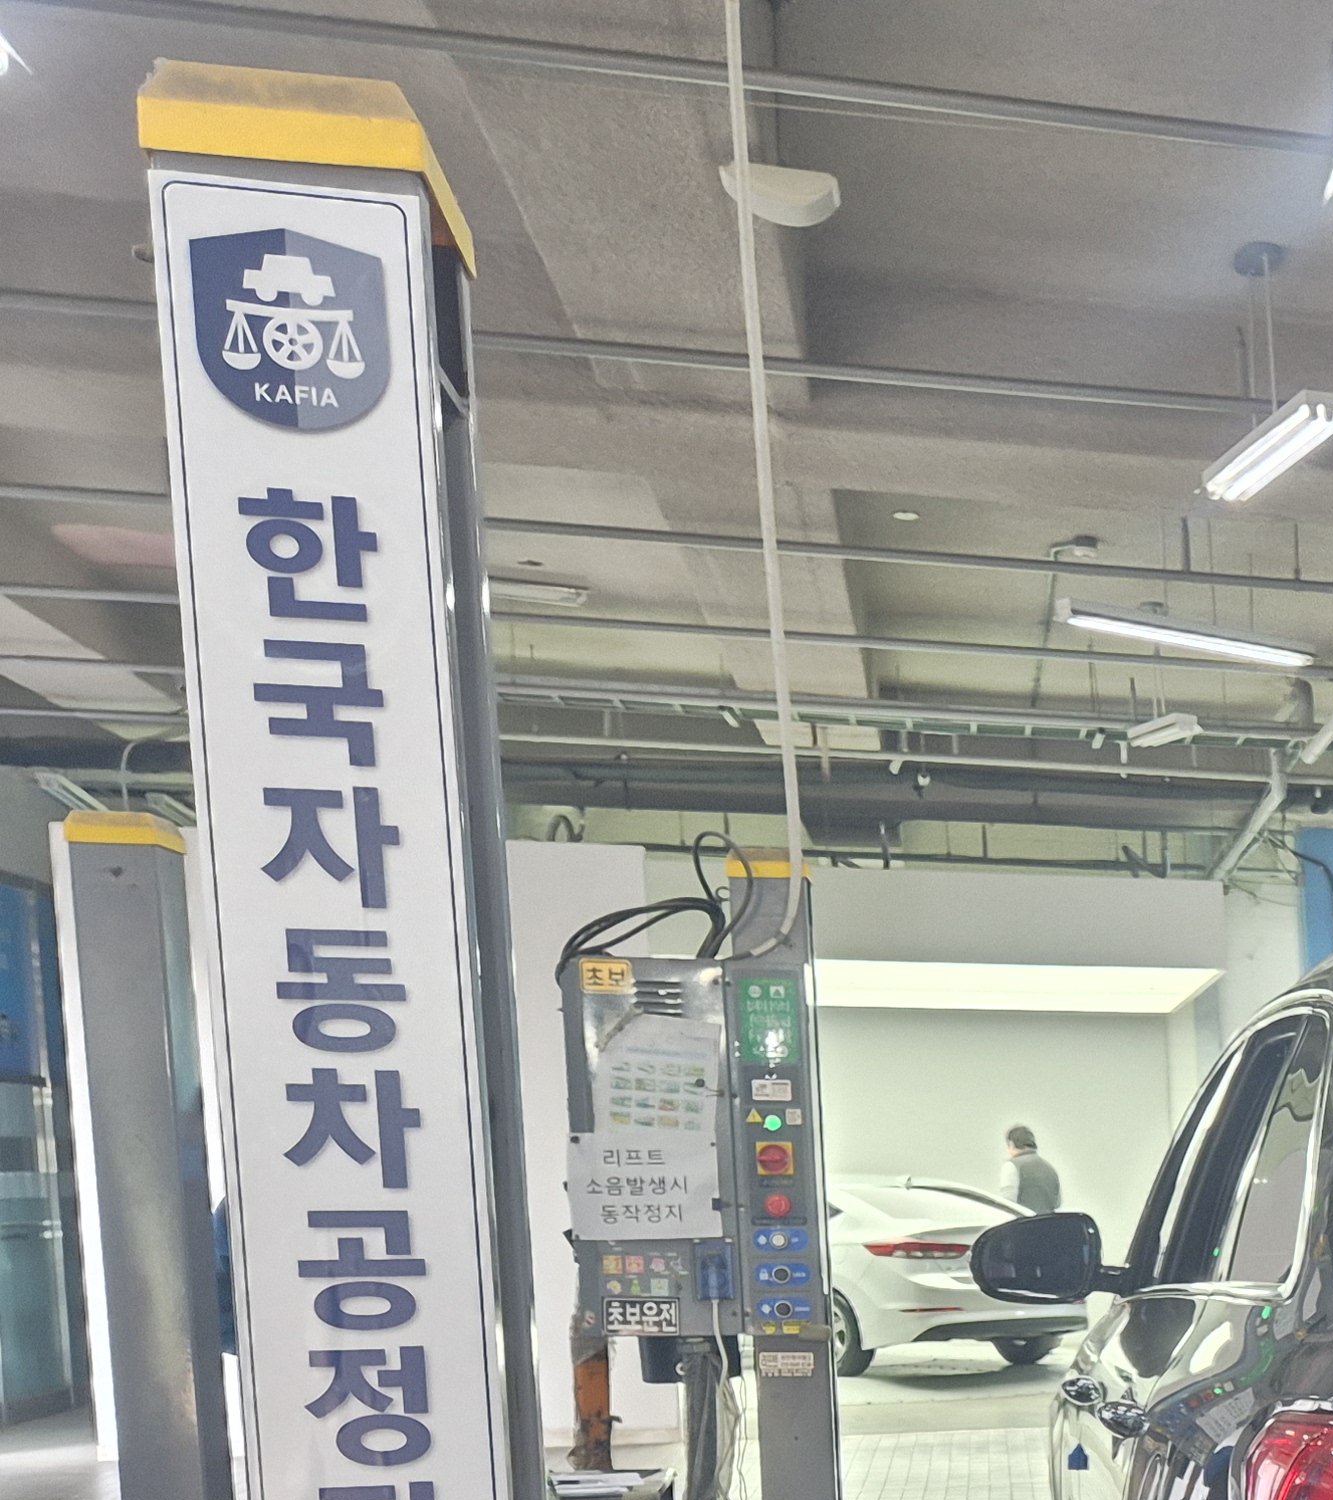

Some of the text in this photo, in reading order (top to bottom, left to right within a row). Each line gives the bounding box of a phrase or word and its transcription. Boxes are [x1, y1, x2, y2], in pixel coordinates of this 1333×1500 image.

[253, 382, 339, 409] KAFIA
[586, 966, 626, 987] 초보
[602, 1148, 667, 1168] 리프트
[586, 1175, 688, 1197] 소음발생시
[600, 1203, 684, 1225] 동작정지
[606, 1300, 678, 1333] 초보운전
